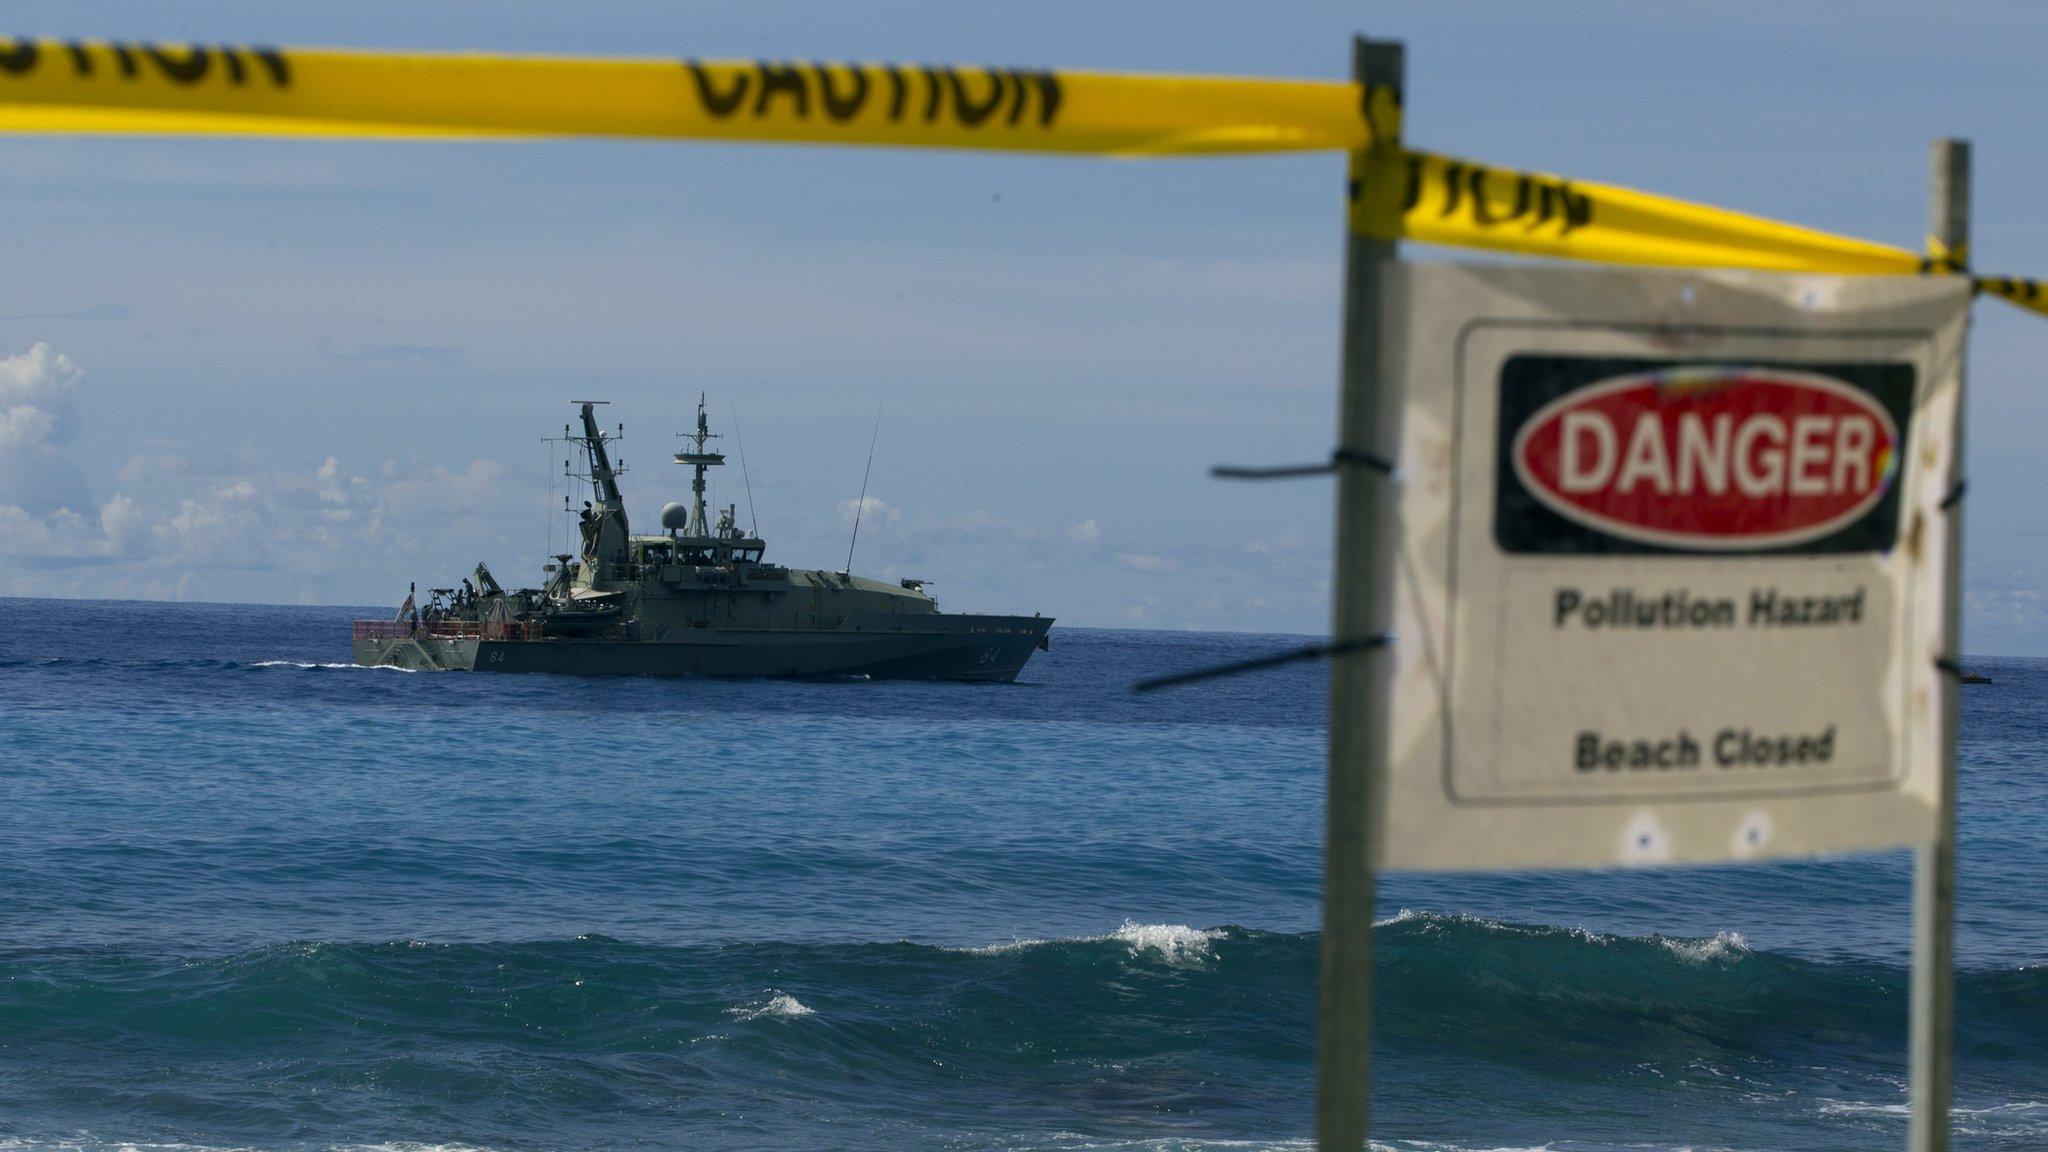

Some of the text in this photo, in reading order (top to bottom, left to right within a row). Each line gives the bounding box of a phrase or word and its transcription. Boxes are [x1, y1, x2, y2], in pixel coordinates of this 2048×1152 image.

[685, 60, 1063, 128] CAUTION
[1558, 409, 1876, 498] DANGER
[1553, 585, 1866, 630] Pollution Hazard
[489, 652, 504, 663] 84
[1574, 723, 1837, 772] Beach Closed
